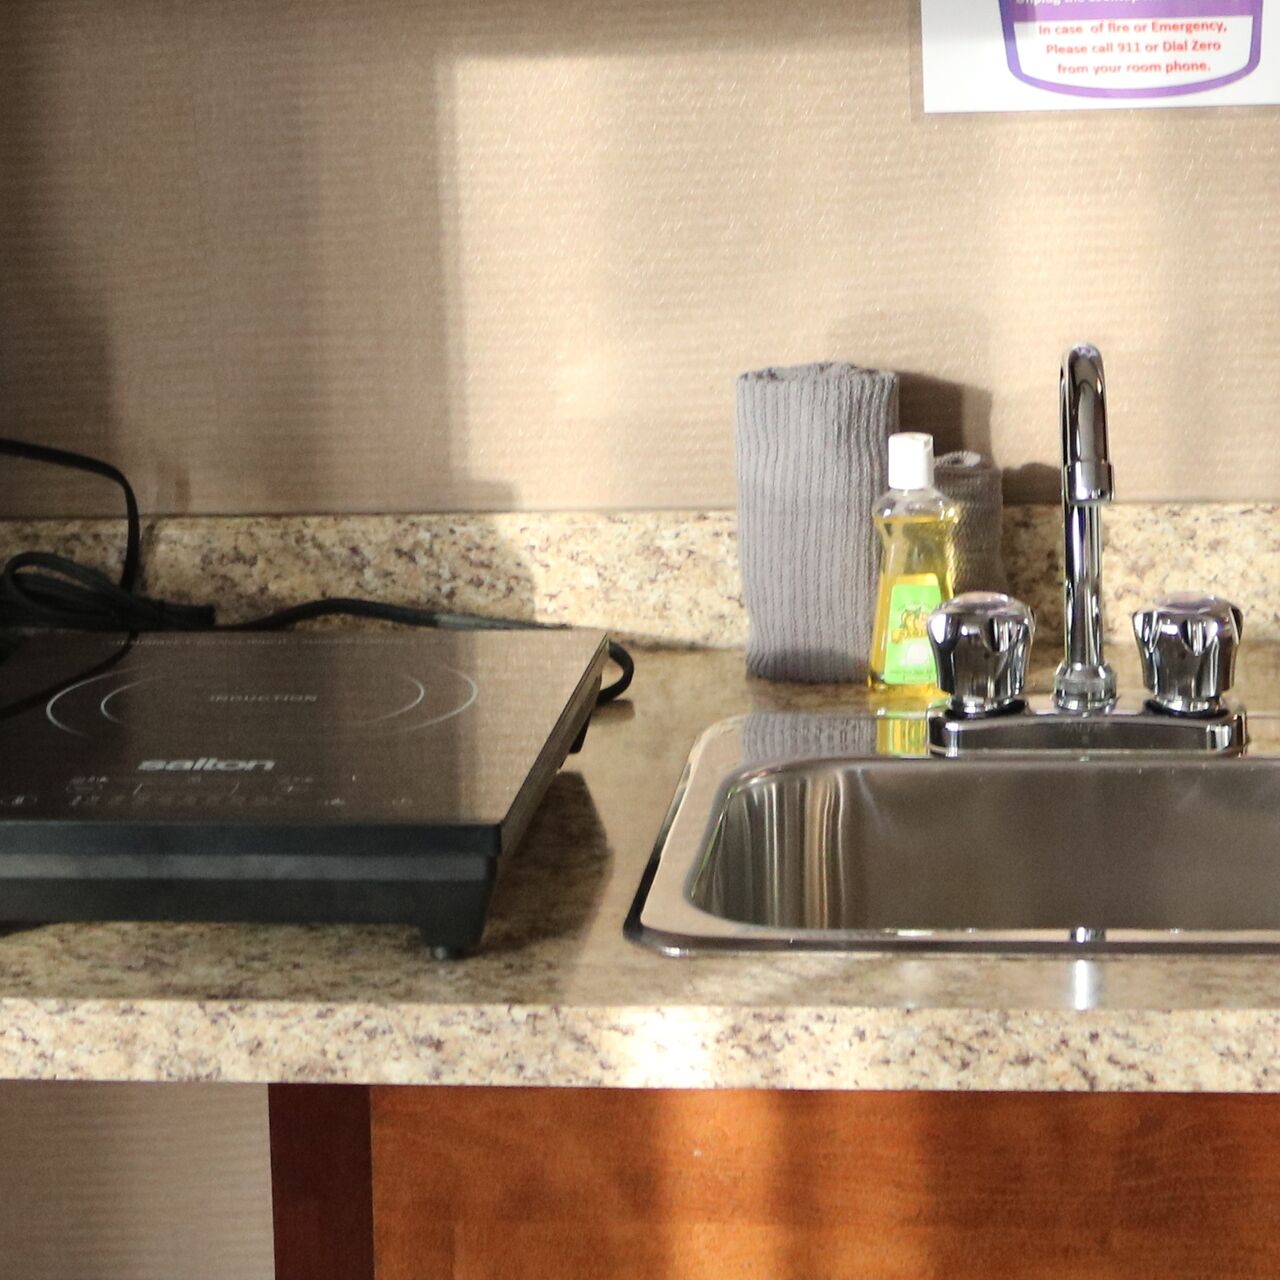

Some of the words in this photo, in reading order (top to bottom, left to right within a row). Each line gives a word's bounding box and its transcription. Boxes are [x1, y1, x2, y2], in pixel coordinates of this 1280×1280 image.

[1038, 24, 1051, 35] In
[1055, 25, 1083, 35] case
[1090, 22, 1105, 34] of
[1108, 22, 1130, 33] fire
[1134, 23, 1147, 33] or
[1151, 21, 1228, 34] Emergency,
[1046, 43, 1087, 54] Please
[1091, 42, 1114, 53] call
[1117, 42, 1141, 52] 911
[1144, 42, 1158, 52] or
[1163, 40, 1188, 52] Dial
[1192, 40, 1221, 52] Zero
[1057, 63, 1088, 74] from
[1092, 63, 1121, 75] your
[1126, 63, 1161, 73] room
[1165, 60, 1211, 74] phone.
[137, 756, 276, 771] salton
